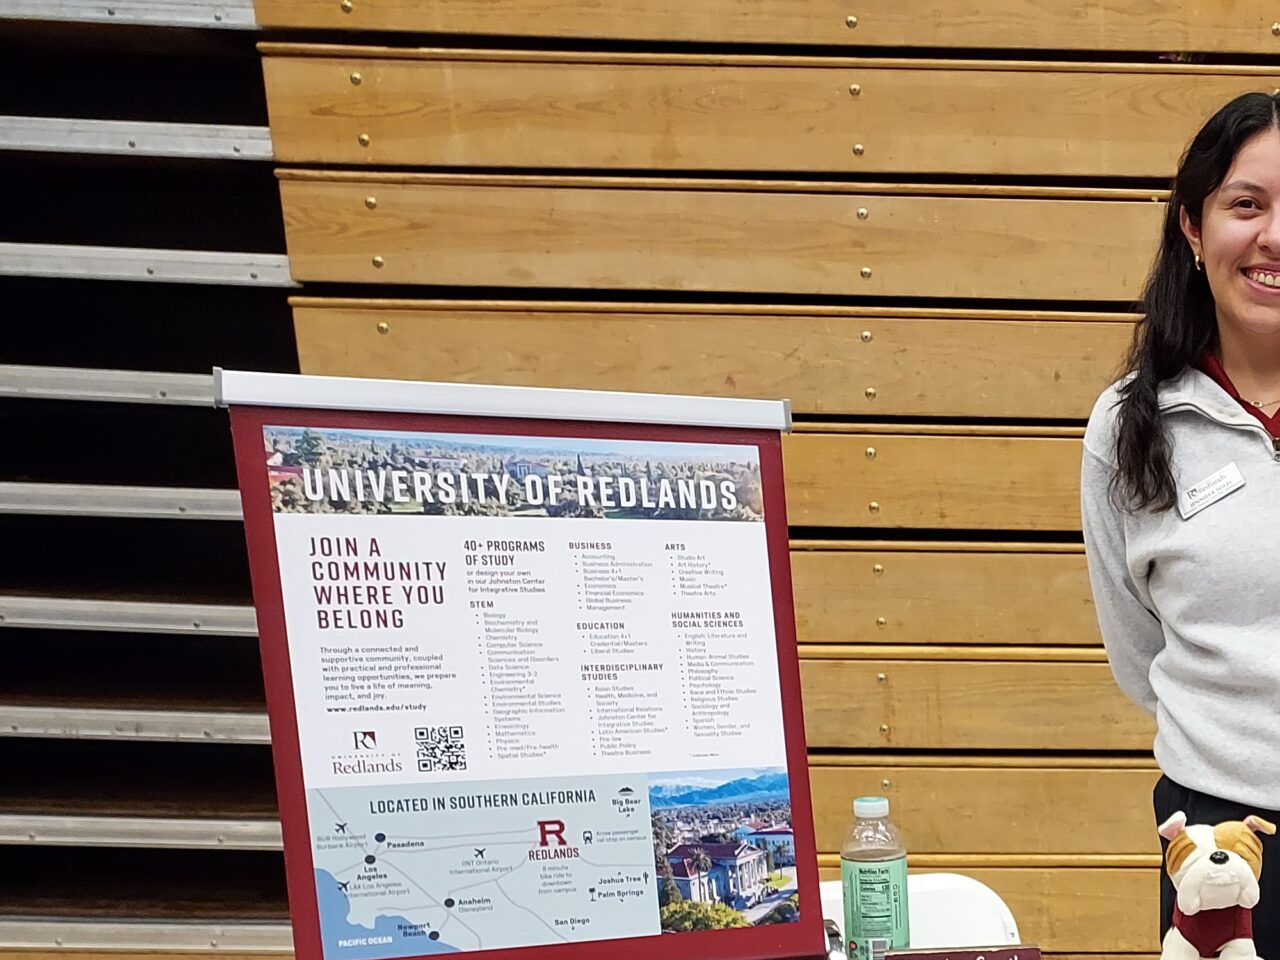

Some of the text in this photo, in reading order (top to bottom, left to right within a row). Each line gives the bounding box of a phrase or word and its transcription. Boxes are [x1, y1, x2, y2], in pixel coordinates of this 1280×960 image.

[301, 466, 738, 511] UNIVERSITY OF REDLANDS
[309, 536, 382, 557] JOIN A
[463, 540, 545, 552] 40+ PROGRAMS
[569, 542, 612, 550] BUSINESS
[465, 554, 515, 566] OF STUDY
[311, 561, 446, 581] COMMUNITY
[475, 569, 498, 577] design
[314, 585, 444, 605] WHERE YOU
[480, 586, 518, 594] Integrative
[317, 609, 404, 629] BELONG
[704, 620, 744, 628] SCIENCES
[576, 622, 625, 630] EDUCATION
[320, 646, 353, 654] Through
[321, 654, 443, 664] supportive community, coupled
[341, 664, 376, 673] practical
[394, 663, 441, 672] professional
[580, 664, 664, 672] INTERDISCIPLINARY
[322, 674, 355, 682] learning
[357, 673, 413, 681] opportunities,
[427, 672, 456, 680] prepare
[581, 673, 618, 681] STUDIES
[324, 684, 338, 692] you
[350, 682, 364, 690] live
[397, 682, 433, 690] meaning,
[325, 693, 355, 701] impact,
[373, 692, 387, 701] joy.
[326, 704, 427, 713] www.redlands.edu/study
[332, 759, 403, 775] Redlands
[369, 789, 596, 814] LOCATED IN SOUTHERN CALIFORNIA
[537, 819, 567, 847] R
[387, 840, 425, 849] Pasadena
[528, 847, 579, 861] REDLANDS
[356, 873, 387, 881] Angeles
[598, 877, 624, 885] Joshua
[617, 889, 644, 898] Springs
[458, 898, 491, 906] Anaheim
[554, 916, 590, 926] San Diego
[397, 922, 430, 931] Newport
[338, 936, 393, 947] PACIFIC OCEAN
